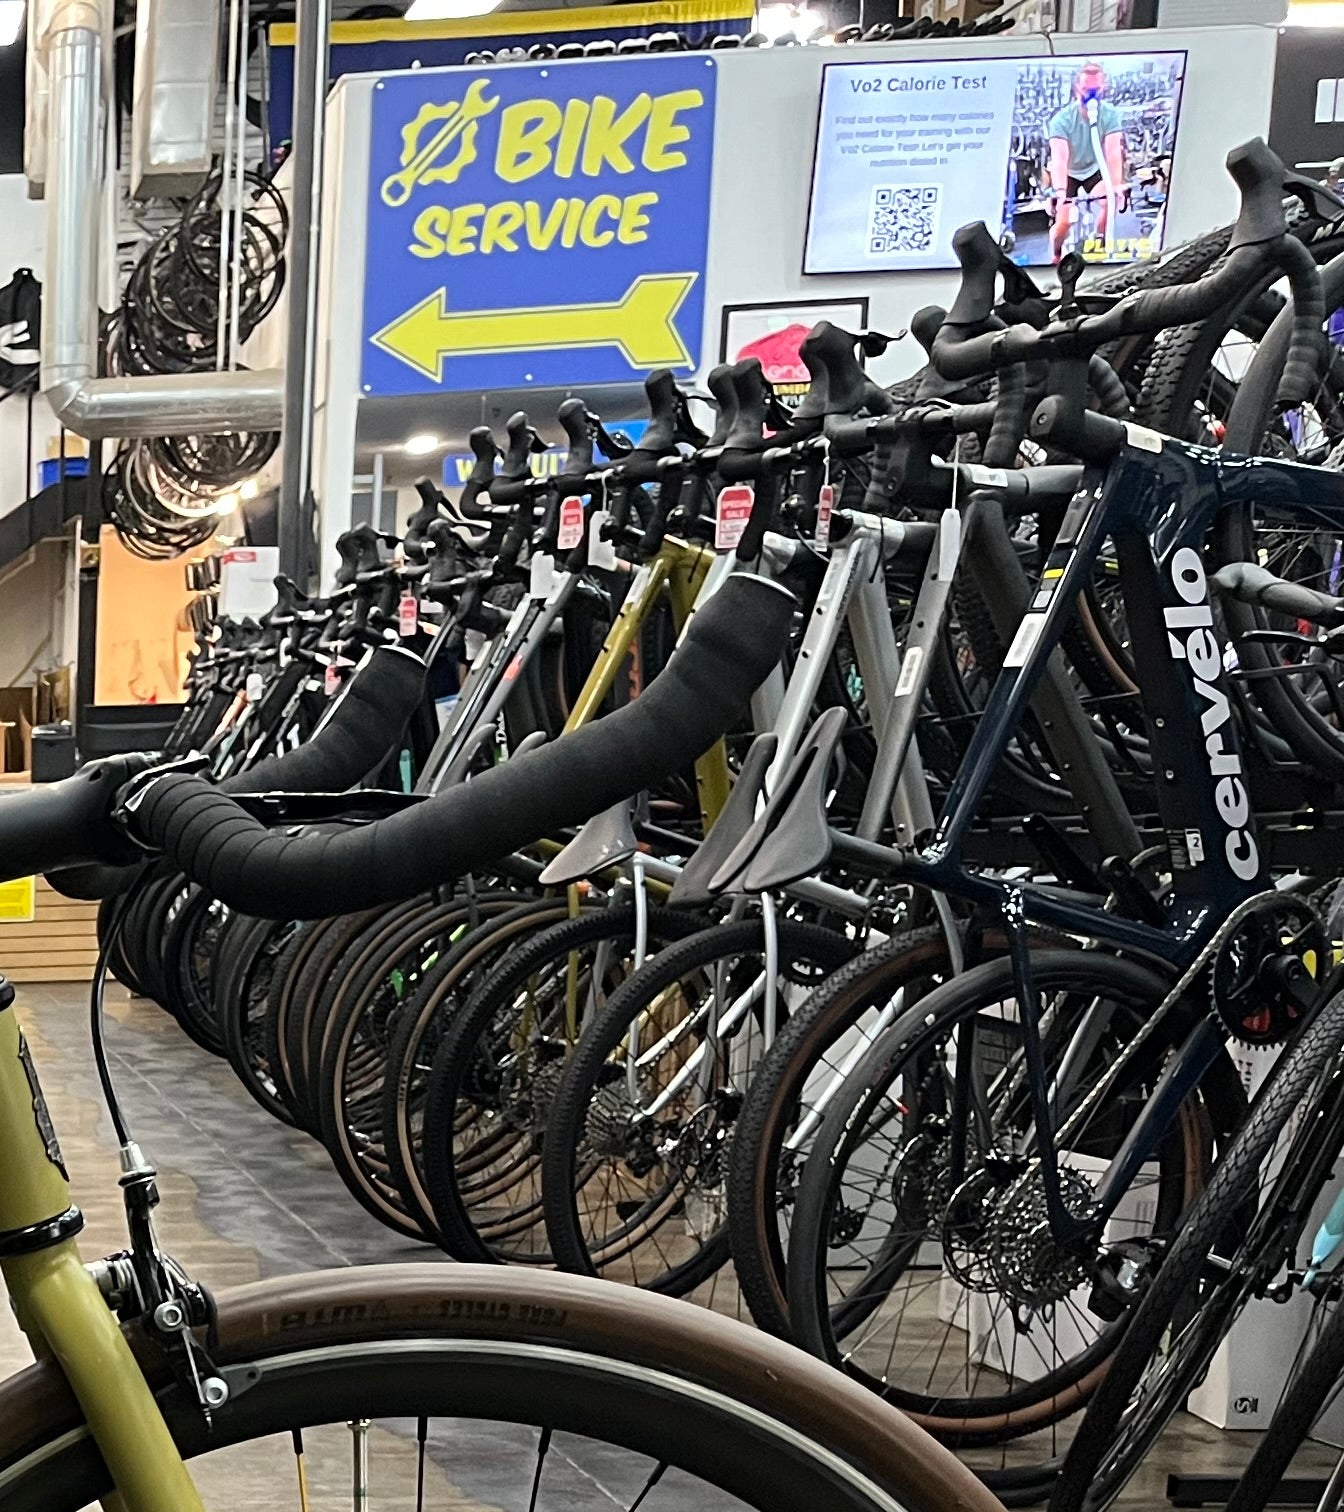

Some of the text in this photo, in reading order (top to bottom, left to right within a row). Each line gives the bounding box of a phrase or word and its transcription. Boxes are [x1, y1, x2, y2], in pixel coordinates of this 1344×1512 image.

[850, 75, 987, 93] Vo2 Calorie Test
[494, 89, 703, 183] BIKE
[409, 192, 659, 259] SERVICE
[1162, 547, 1260, 881] cervélo
